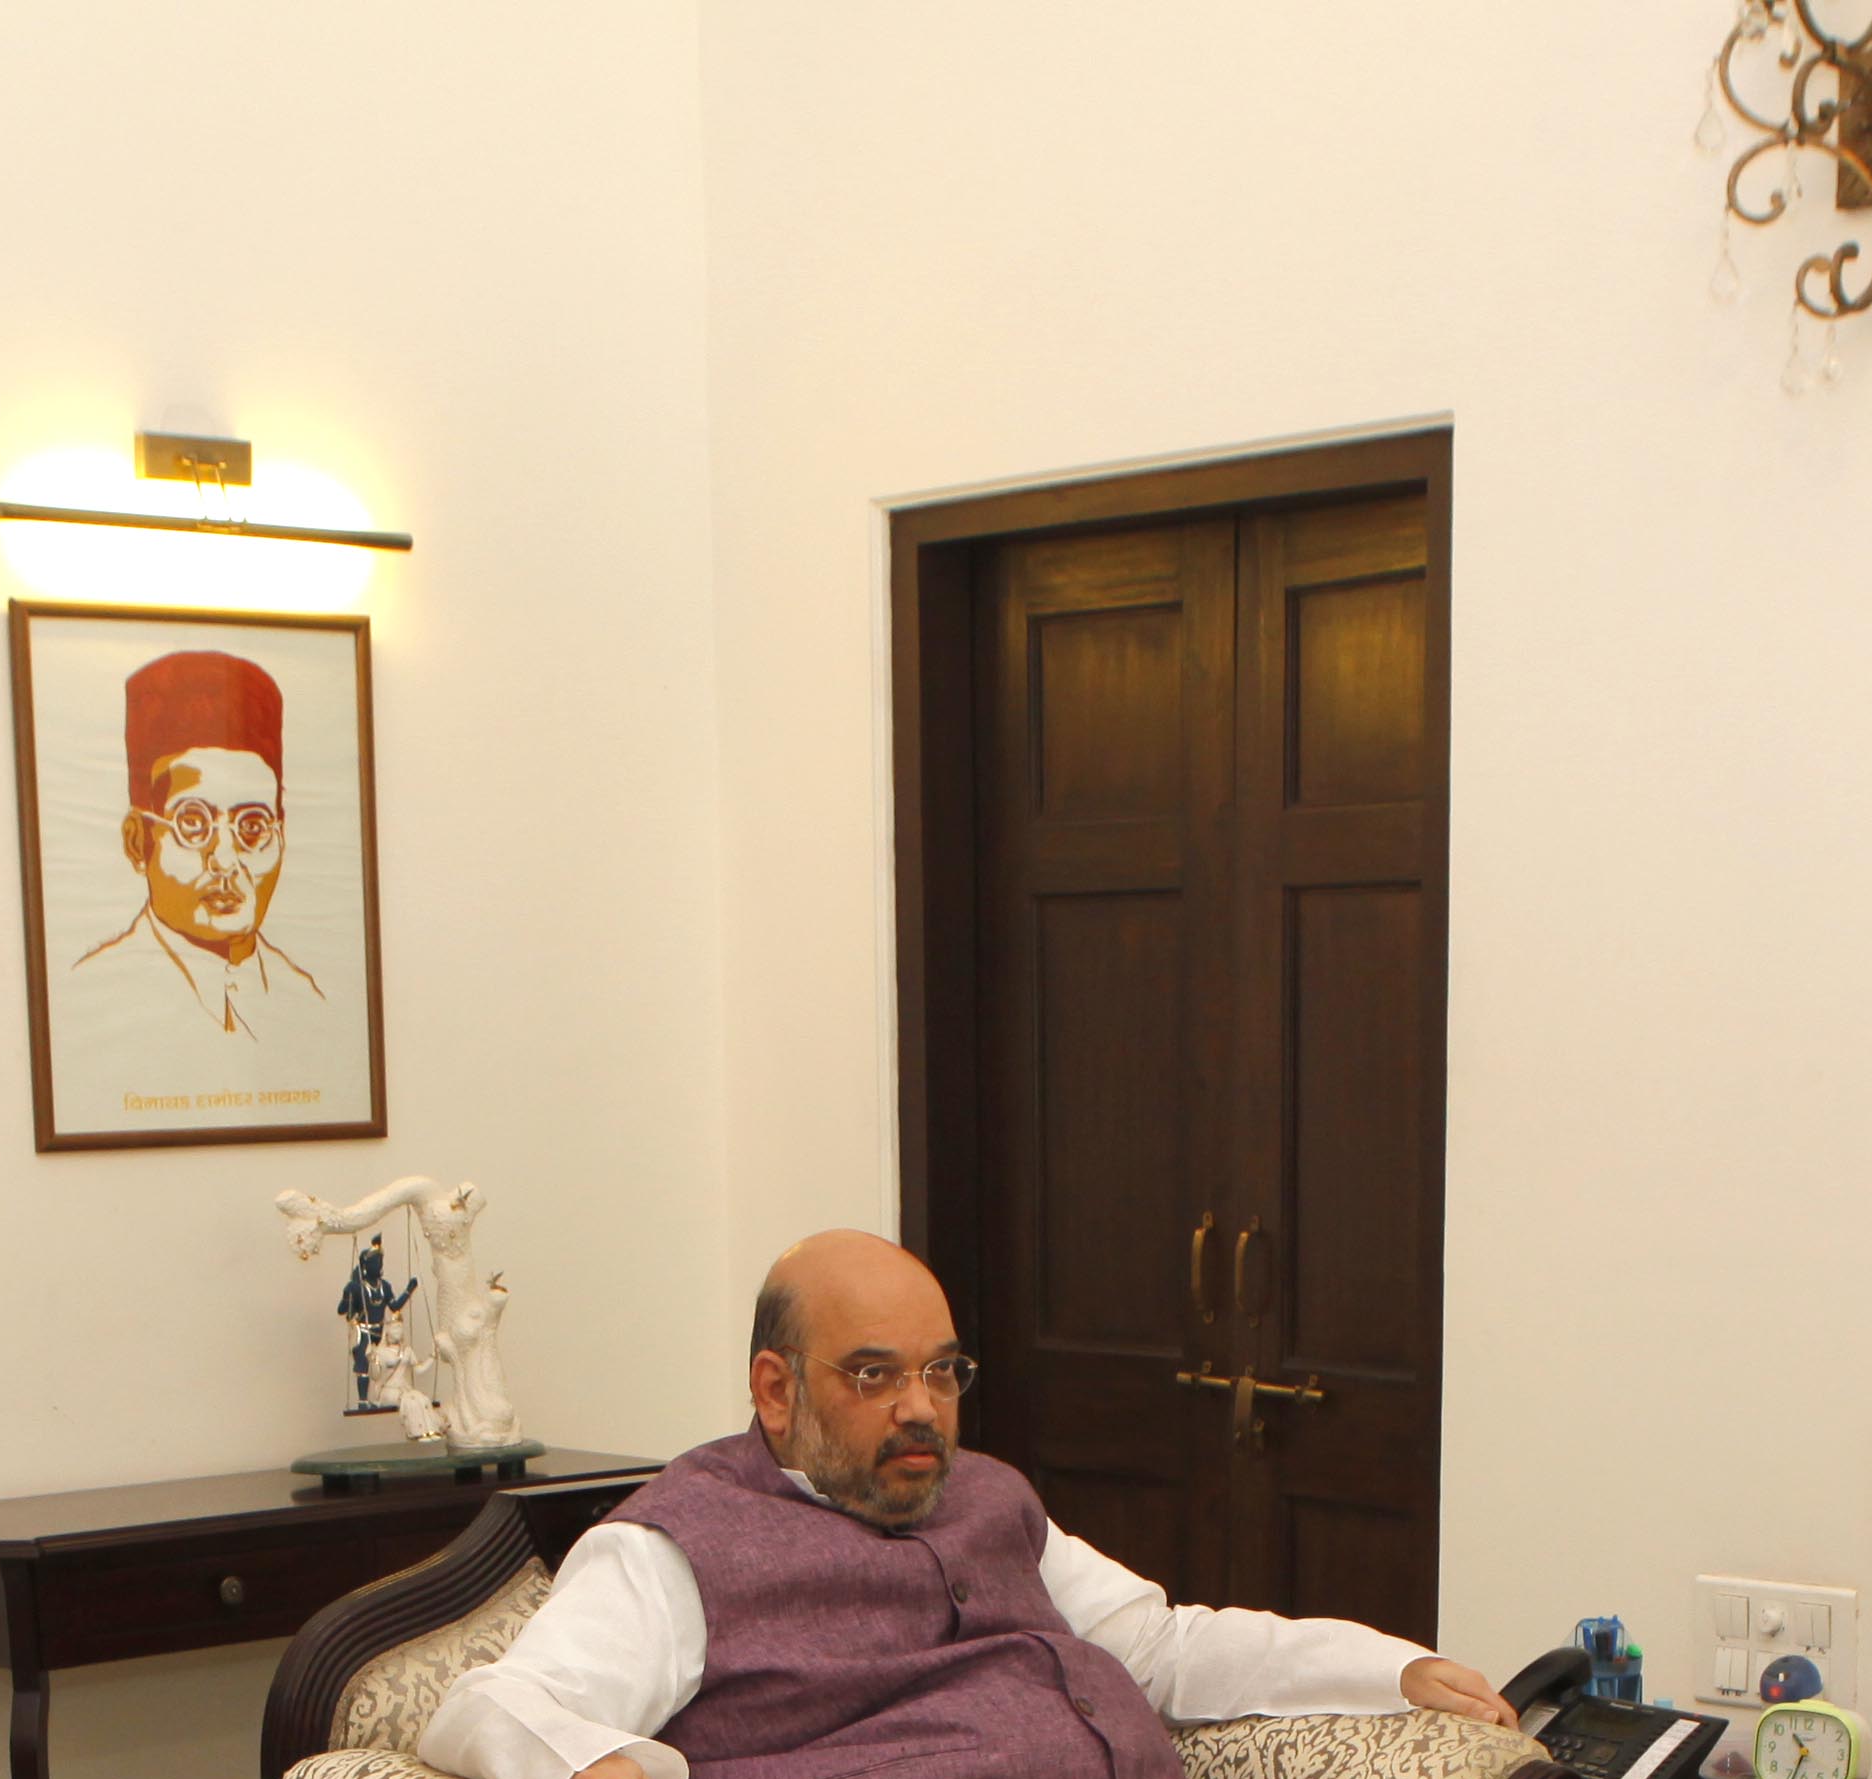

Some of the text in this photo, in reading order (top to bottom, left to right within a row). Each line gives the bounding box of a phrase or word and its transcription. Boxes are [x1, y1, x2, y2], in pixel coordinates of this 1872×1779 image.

[1774, 1722, 1785, 1736] 10
[1804, 1718, 1814, 1730] 12
[1835, 1729, 1844, 1742] 2
[1768, 1740, 1776, 1753] 9
[1837, 1748, 1845, 1762] 3
[1770, 1760, 1778, 1773] 8
[1832, 1767, 1839, 1779] 4
